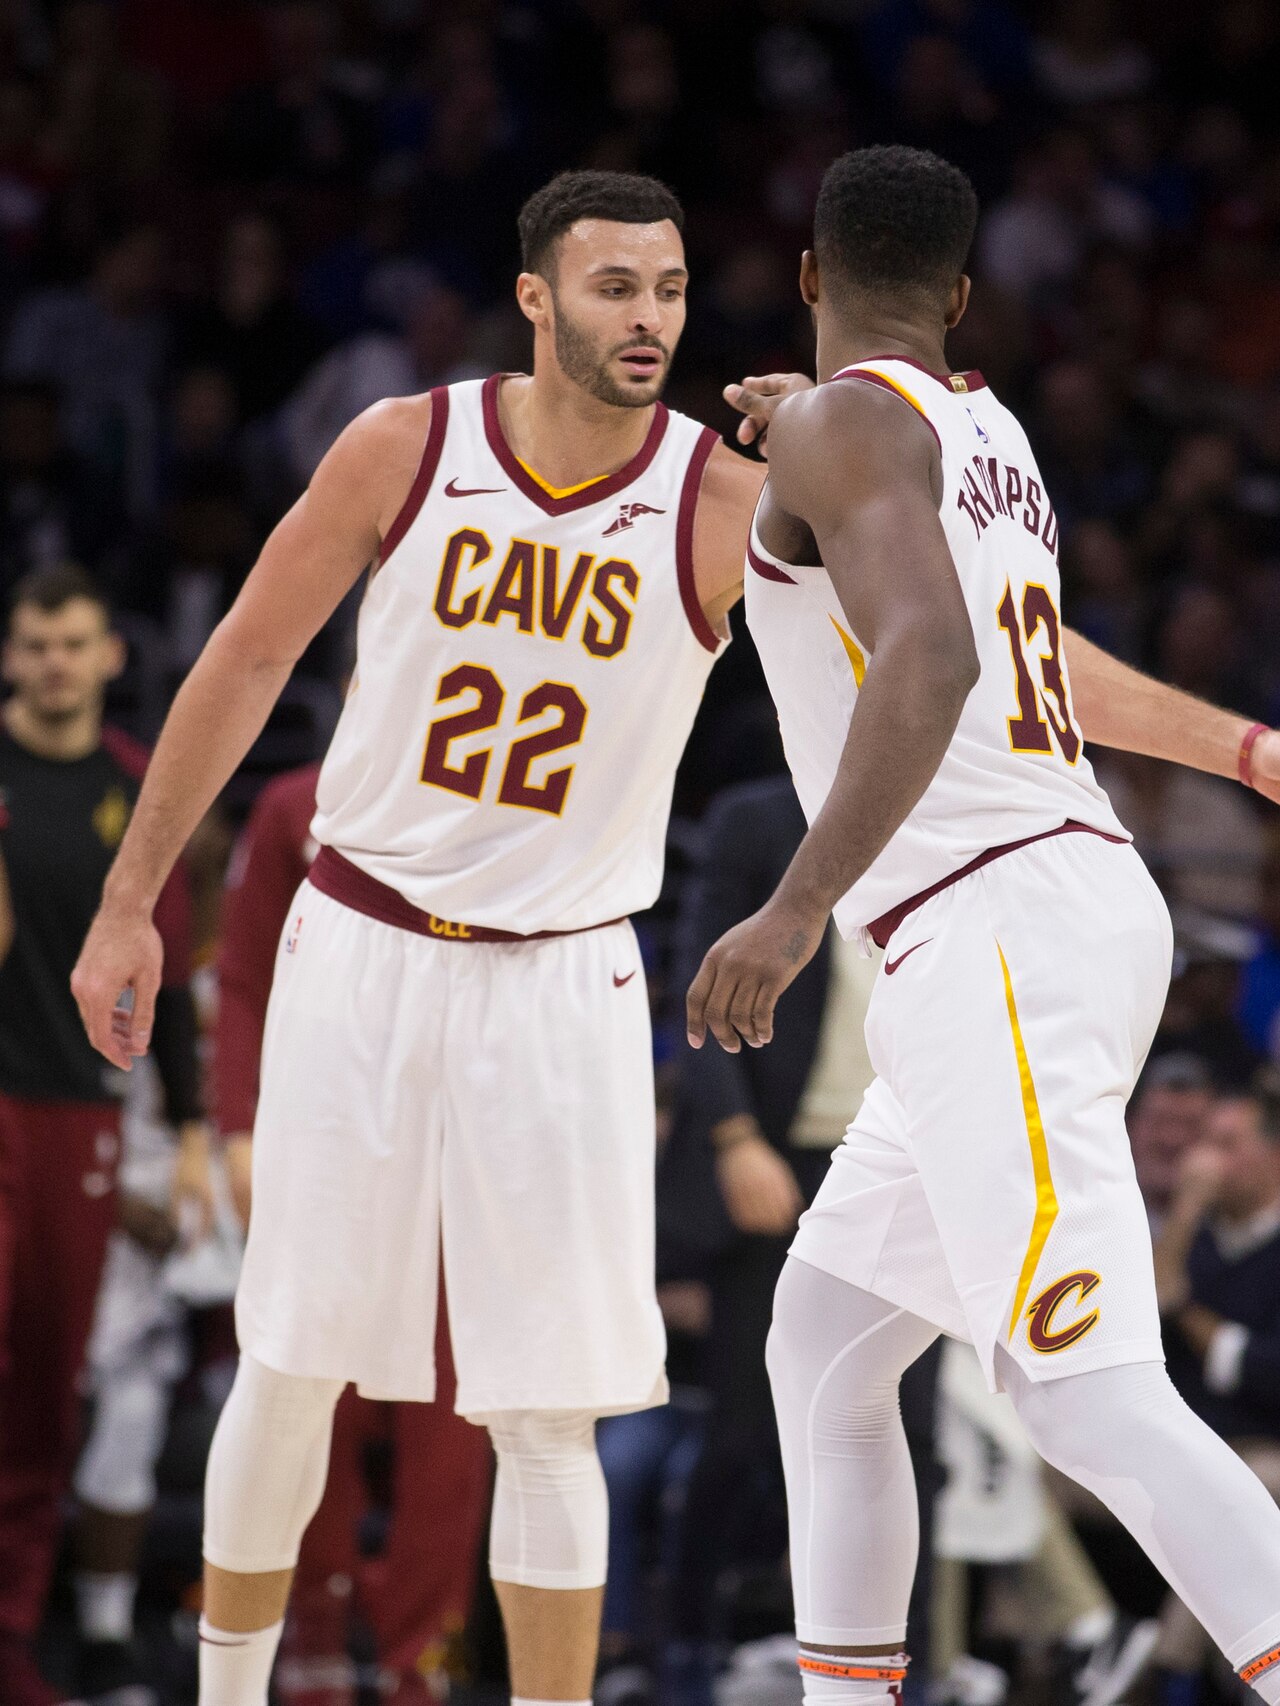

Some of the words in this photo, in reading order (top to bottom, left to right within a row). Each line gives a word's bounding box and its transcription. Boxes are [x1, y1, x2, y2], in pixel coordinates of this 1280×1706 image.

[957, 455, 1059, 568] THOMPSO
[433, 526, 640, 660] CAVS
[996, 572, 1081, 768] 13
[418, 662, 589, 819] 22
[1024, 1269, 1102, 1356] C
